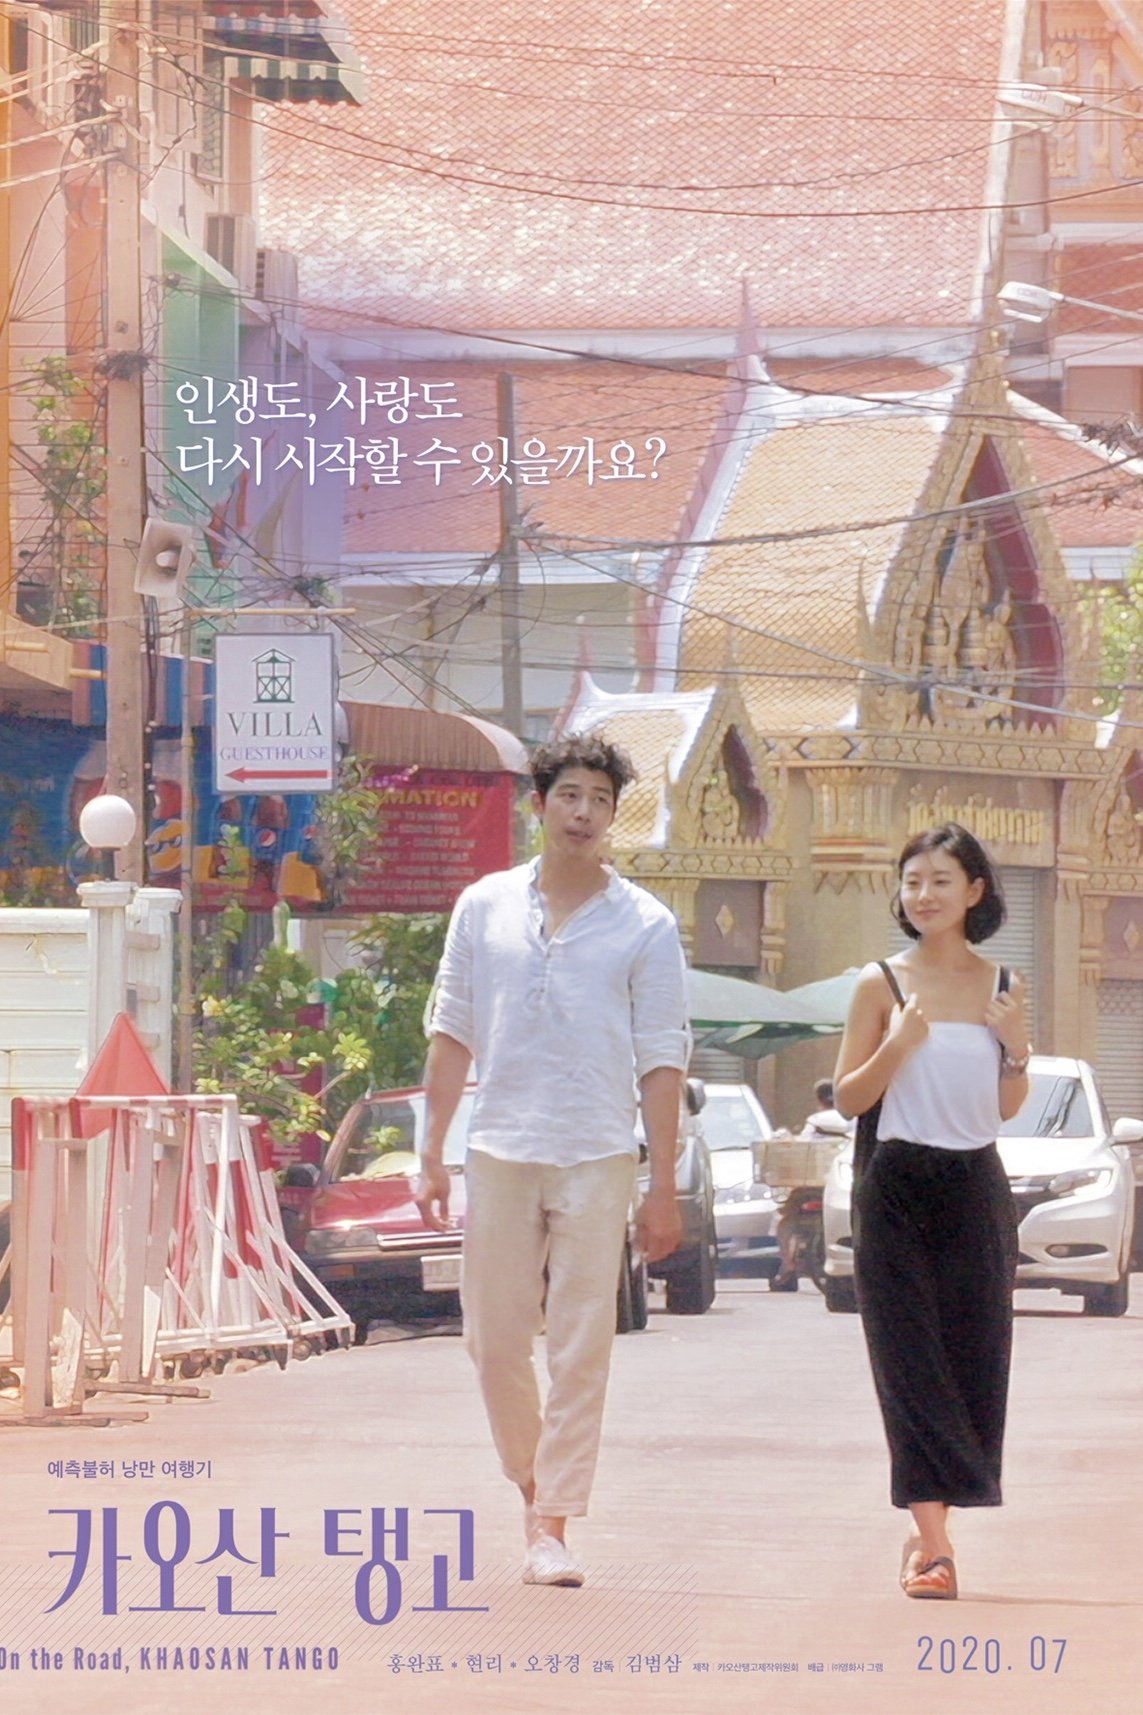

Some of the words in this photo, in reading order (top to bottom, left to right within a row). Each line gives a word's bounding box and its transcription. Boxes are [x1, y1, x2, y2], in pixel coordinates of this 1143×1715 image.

[228, 711, 322, 737] VILLA
[220, 746, 329, 761] GUESTHOUSE
[384, 789, 478, 808] MATION
